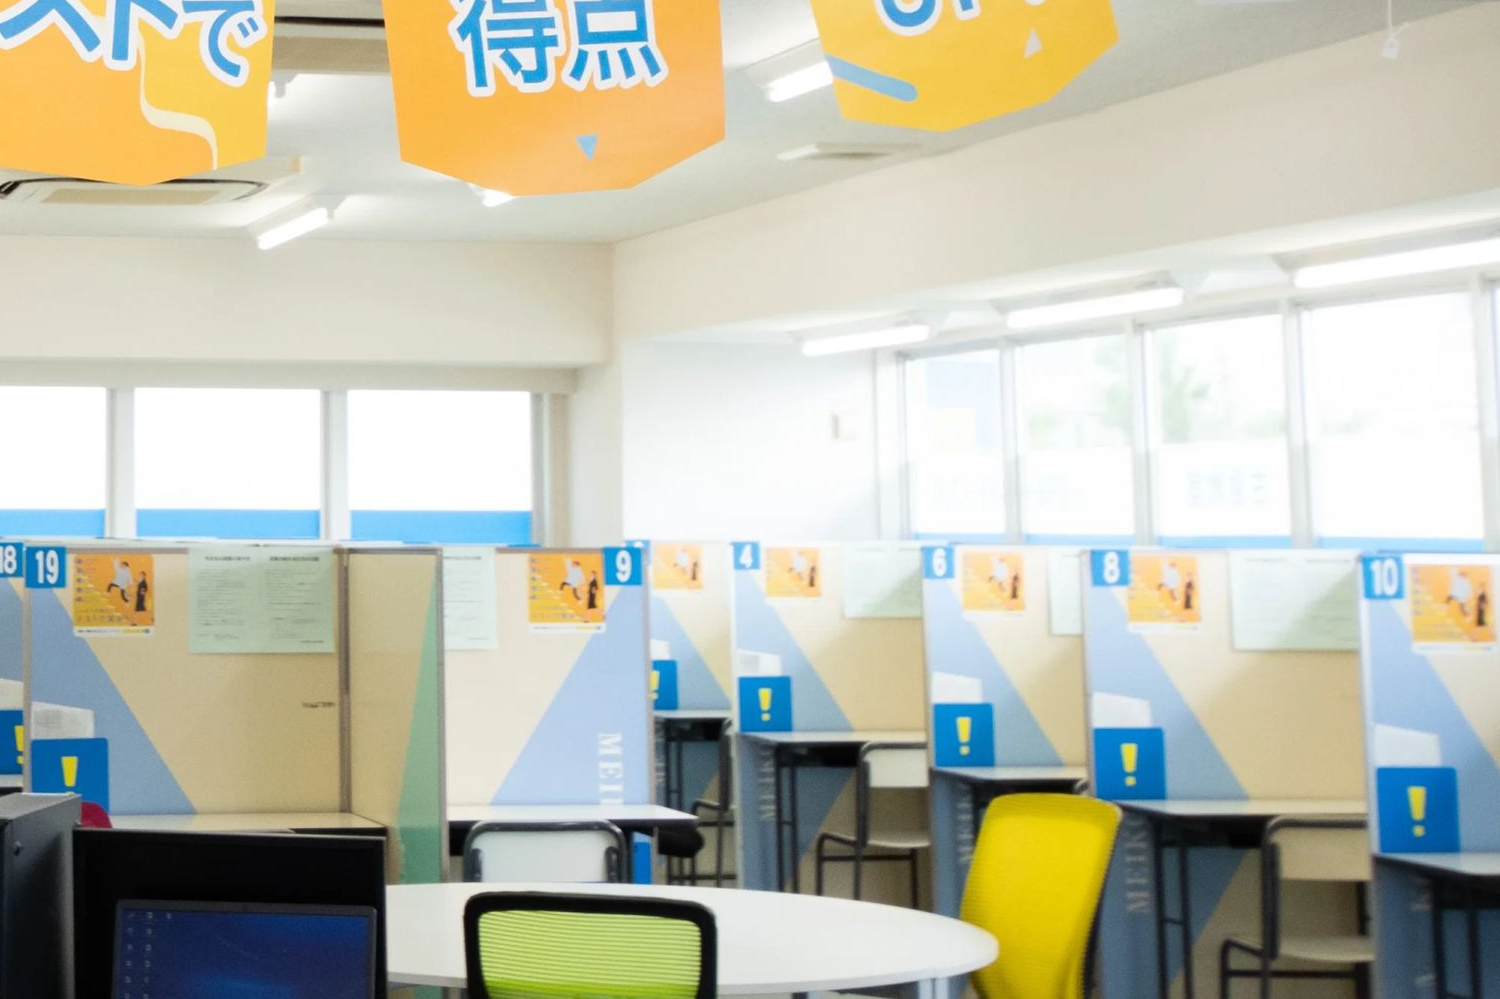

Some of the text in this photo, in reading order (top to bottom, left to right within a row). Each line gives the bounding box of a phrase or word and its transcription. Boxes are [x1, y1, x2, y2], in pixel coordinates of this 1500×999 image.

[35, 549, 59, 584] 19
[615, 549, 632, 583] 9
[738, 545, 754, 568] 4
[931, 549, 946, 577] 6
[1103, 552, 1120, 583] 8
[1370, 558, 1399, 596] 10
